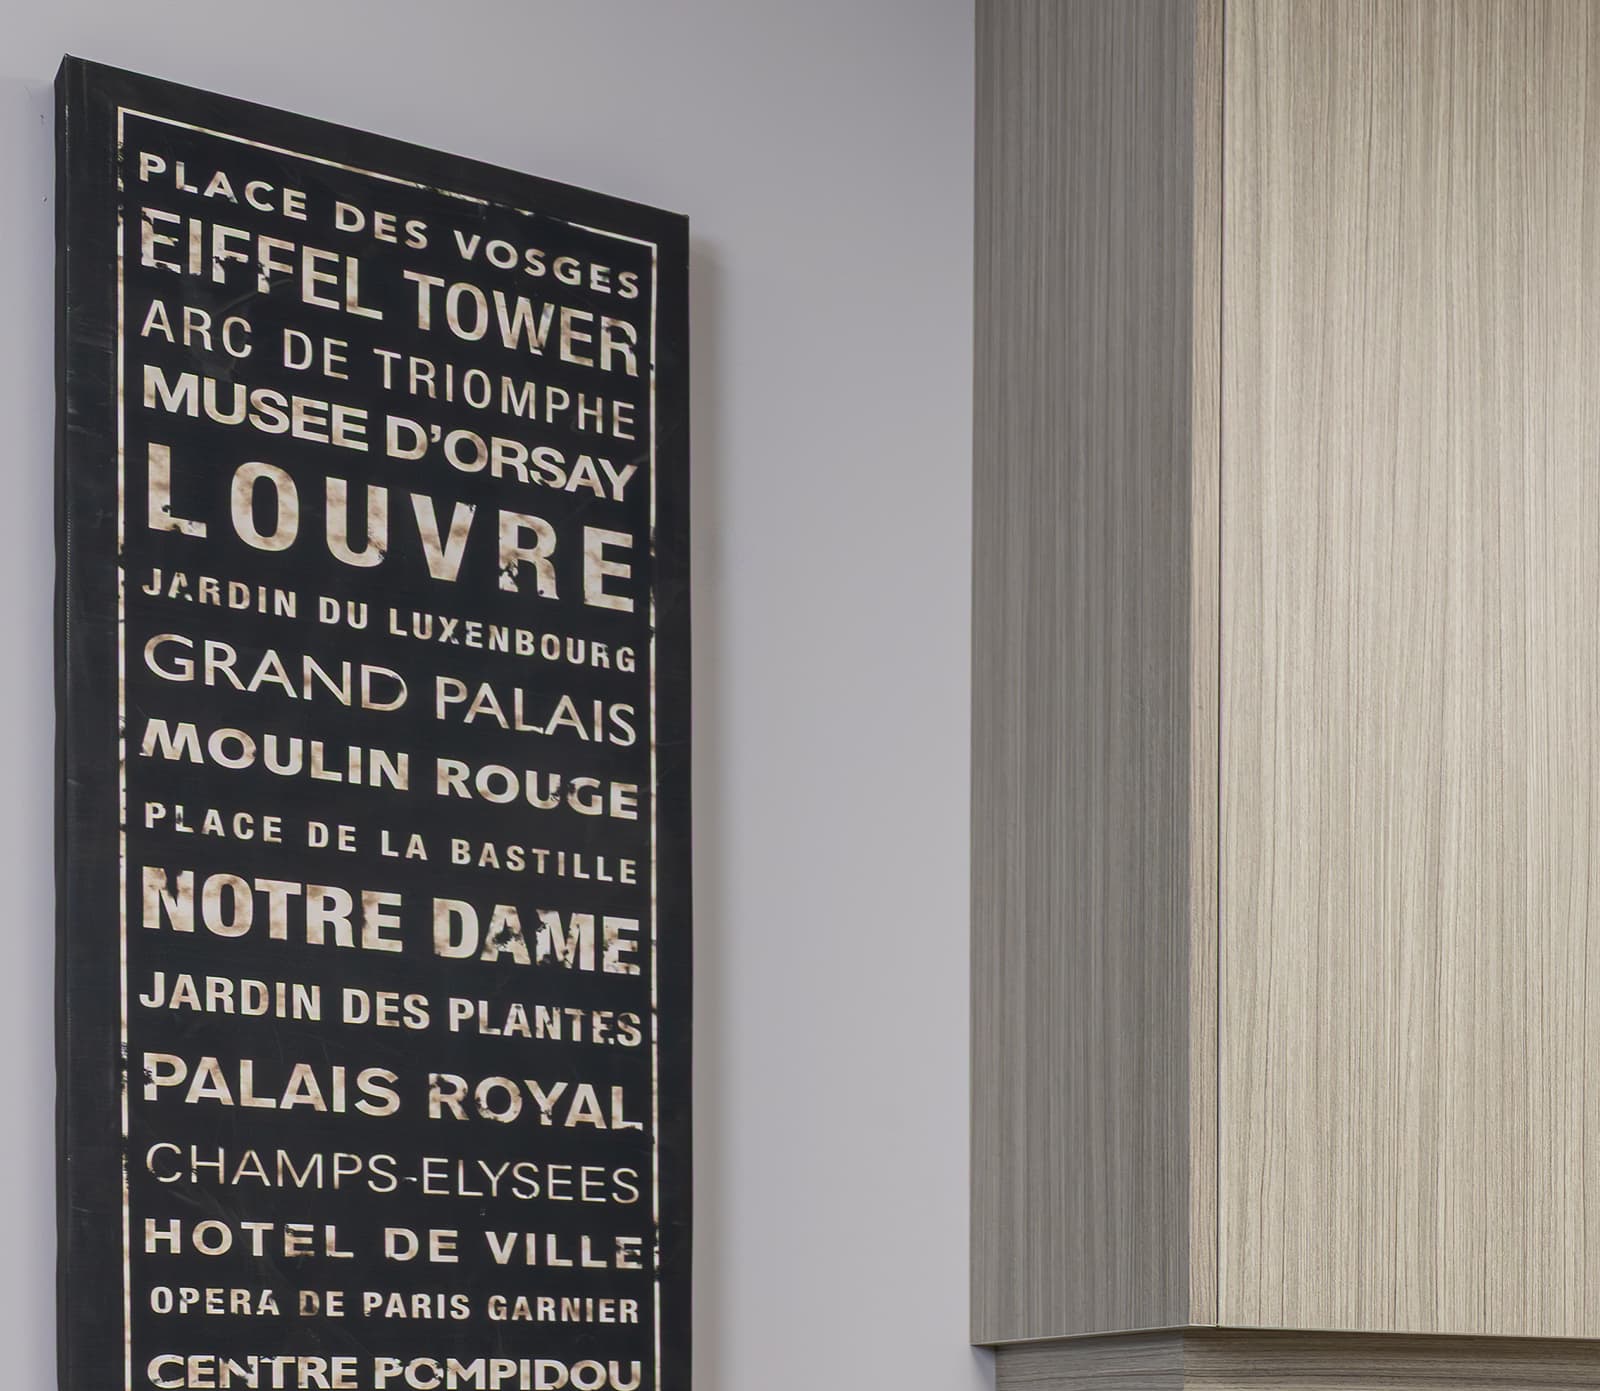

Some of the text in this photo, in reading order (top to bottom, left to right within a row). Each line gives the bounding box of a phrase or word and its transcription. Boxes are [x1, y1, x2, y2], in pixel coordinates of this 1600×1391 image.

[139, 151, 639, 299] PLACE DES VOSGES
[141, 206, 639, 377] EIFFEL TOWER
[141, 299, 636, 441] ARC DE TRIOMPHE
[143, 364, 638, 502] MUSEE D'ORSAY
[147, 441, 635, 613] LOUVRE
[142, 568, 636, 674] JARDIN DU LUXENBOURG
[143, 633, 637, 747] GRAND PALAIS
[139, 717, 639, 821] MOULIN ROUGE
[145, 801, 637, 885] PLACE DE LA BASTILLE
[142, 866, 641, 976] NOTRE DAME
[139, 971, 643, 1048] JARDIN DES PLANTES
[143, 1051, 644, 1132] PALAIS ROYAL
[146, 1142, 641, 1204] CHAMPS-ELYSEES
[144, 1218, 643, 1269] HOTEL DE VILLE
[150, 1286, 640, 1324] OPERA DE PARIS GARNIER
[147, 1354, 641, 1391] CENTRE POMPIDOU
